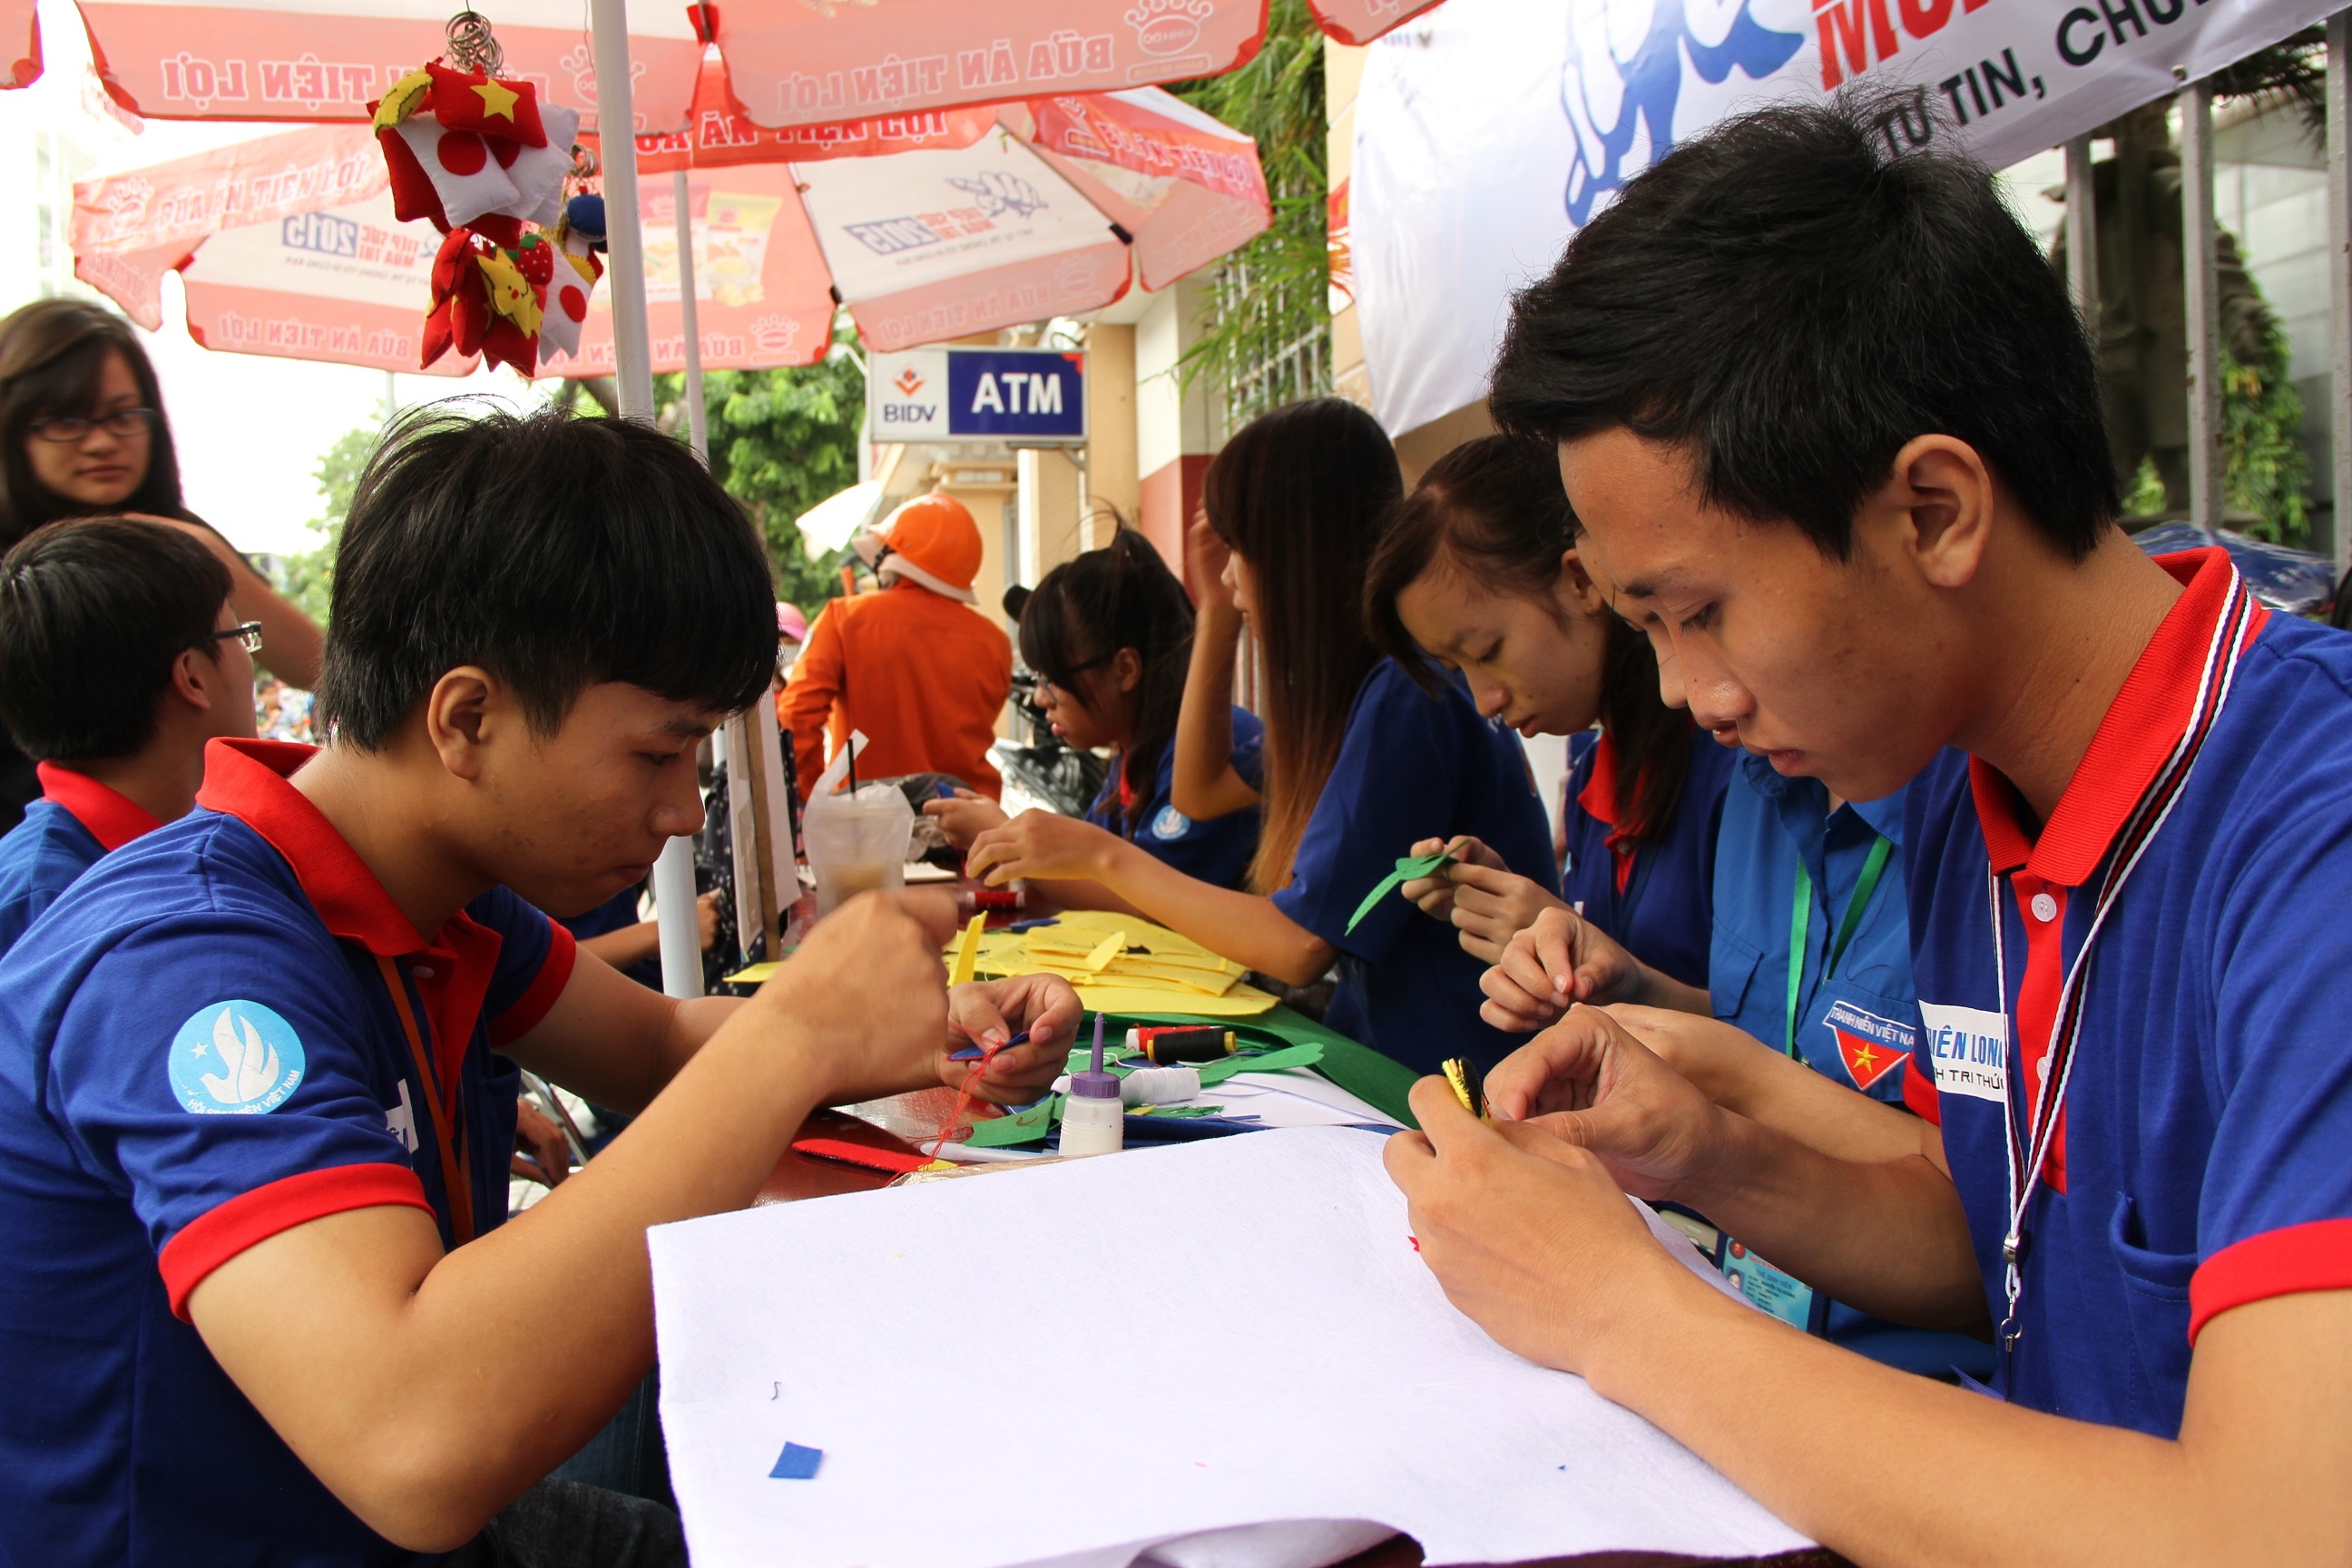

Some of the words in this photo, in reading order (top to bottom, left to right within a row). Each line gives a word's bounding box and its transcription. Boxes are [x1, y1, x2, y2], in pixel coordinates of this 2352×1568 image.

[1939, 47, 2046, 125] TIN,
[2056, 0, 2209, 66] CHU
[970, 372, 1063, 415] ATM
[883, 404, 937, 423] BIDV
[1830, 1006, 1857, 1029] THANH
[1854, 1015, 1876, 1034] NIÊN
[1876, 1024, 1899, 1043] VIỆT
[1899, 1032, 1916, 1046] NA
[261, 1086, 287, 1107] VIỆT
[282, 1069, 301, 1089] NAM
[1948, 1069, 1975, 1083] TRI
